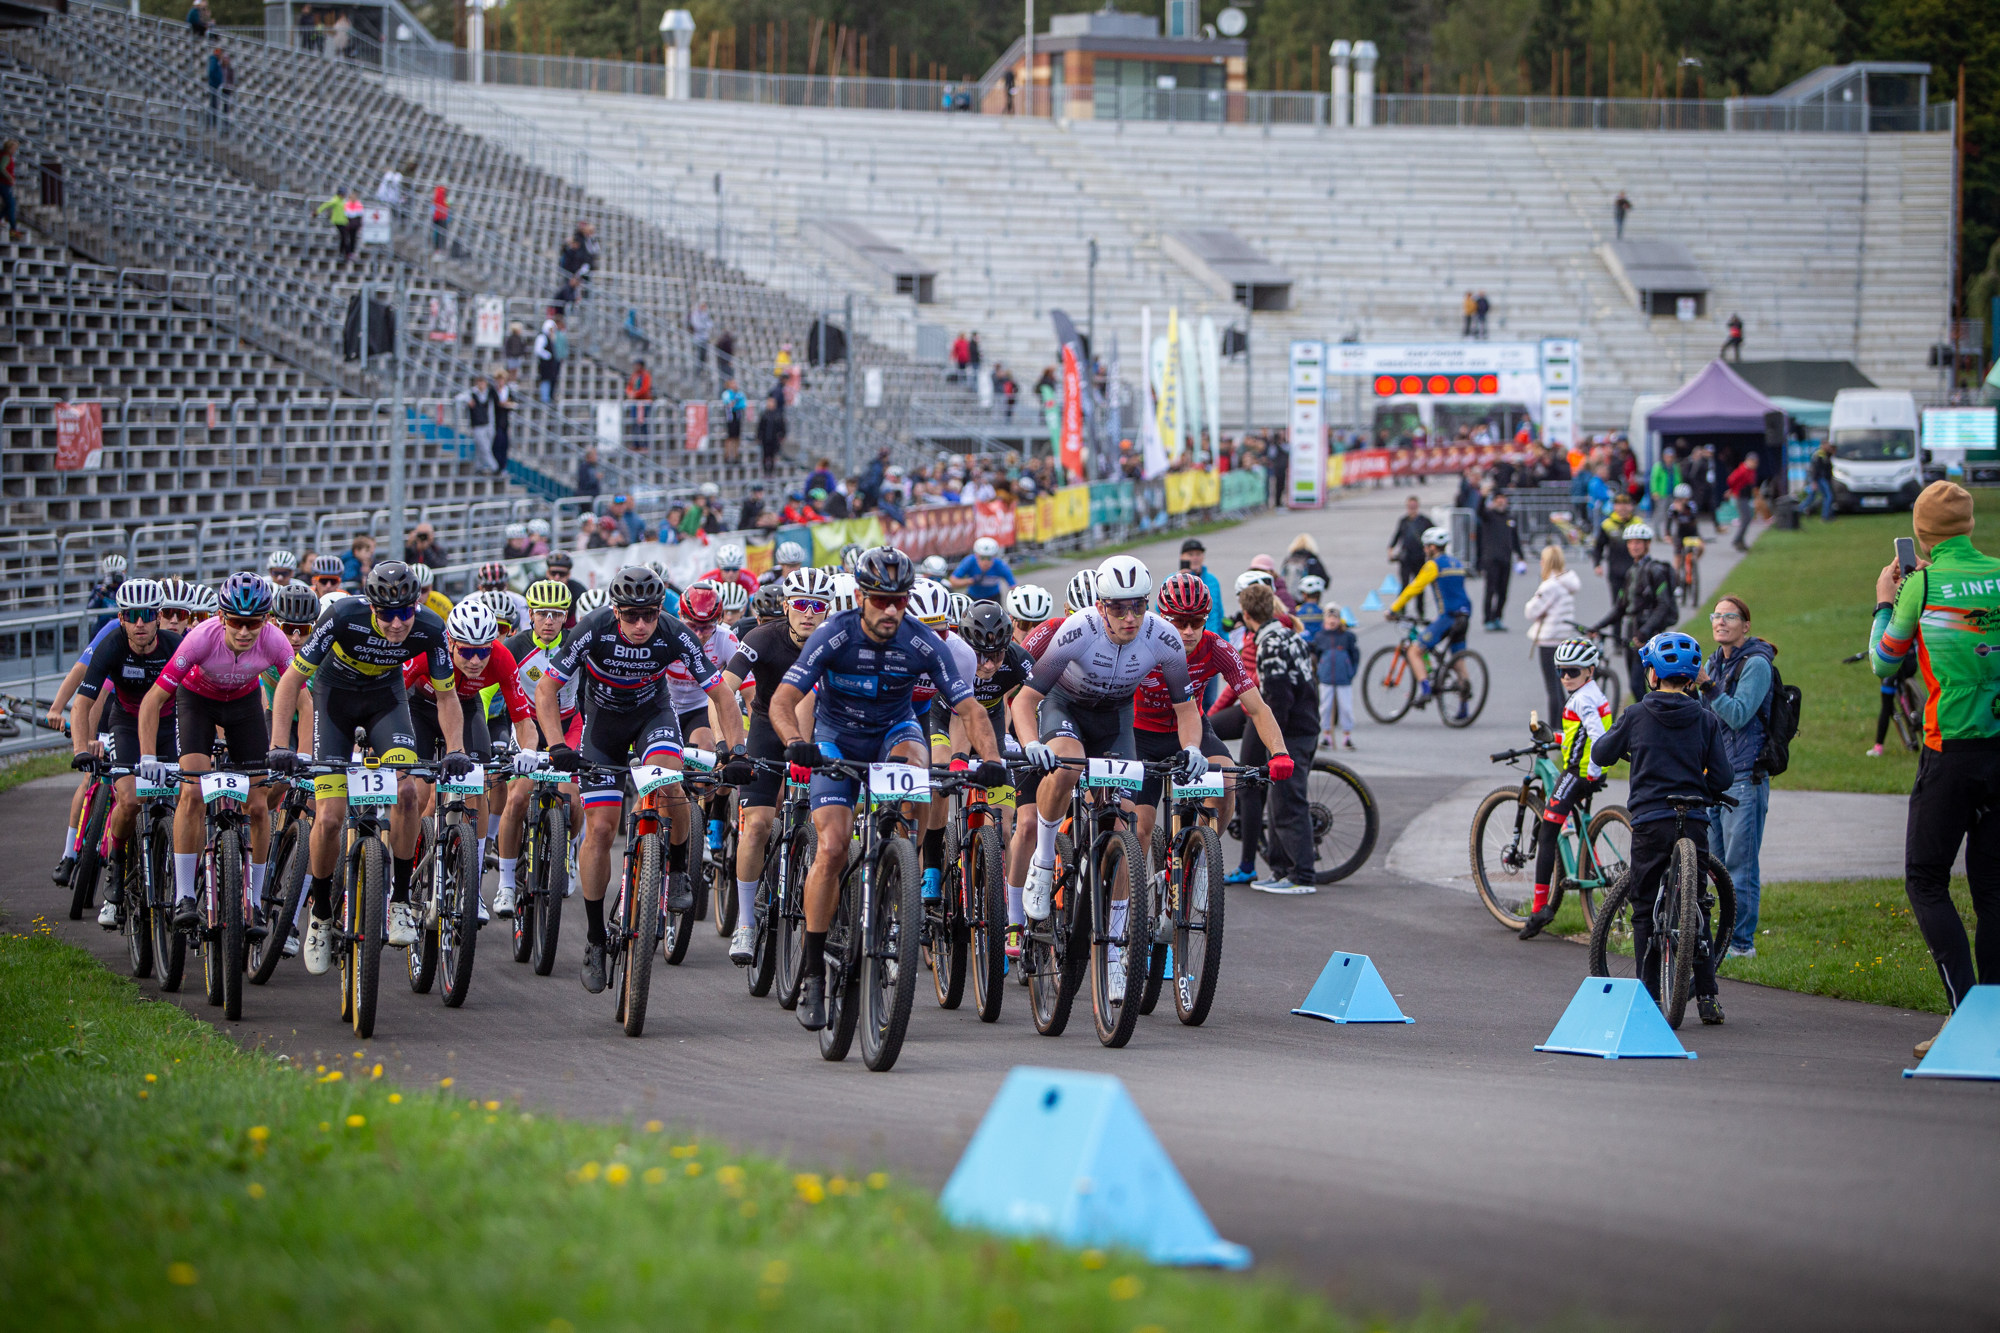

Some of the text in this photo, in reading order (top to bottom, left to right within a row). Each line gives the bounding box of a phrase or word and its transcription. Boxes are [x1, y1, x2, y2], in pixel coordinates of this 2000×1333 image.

[1057, 627, 1083, 648] LAZER
[1158, 631, 1182, 653] LAZER
[651, 768, 663, 777] 4
[1104, 760, 1129, 775] 17
[214, 777, 238, 789] 18
[361, 774, 384, 792] 13
[886, 772, 914, 791] 10
